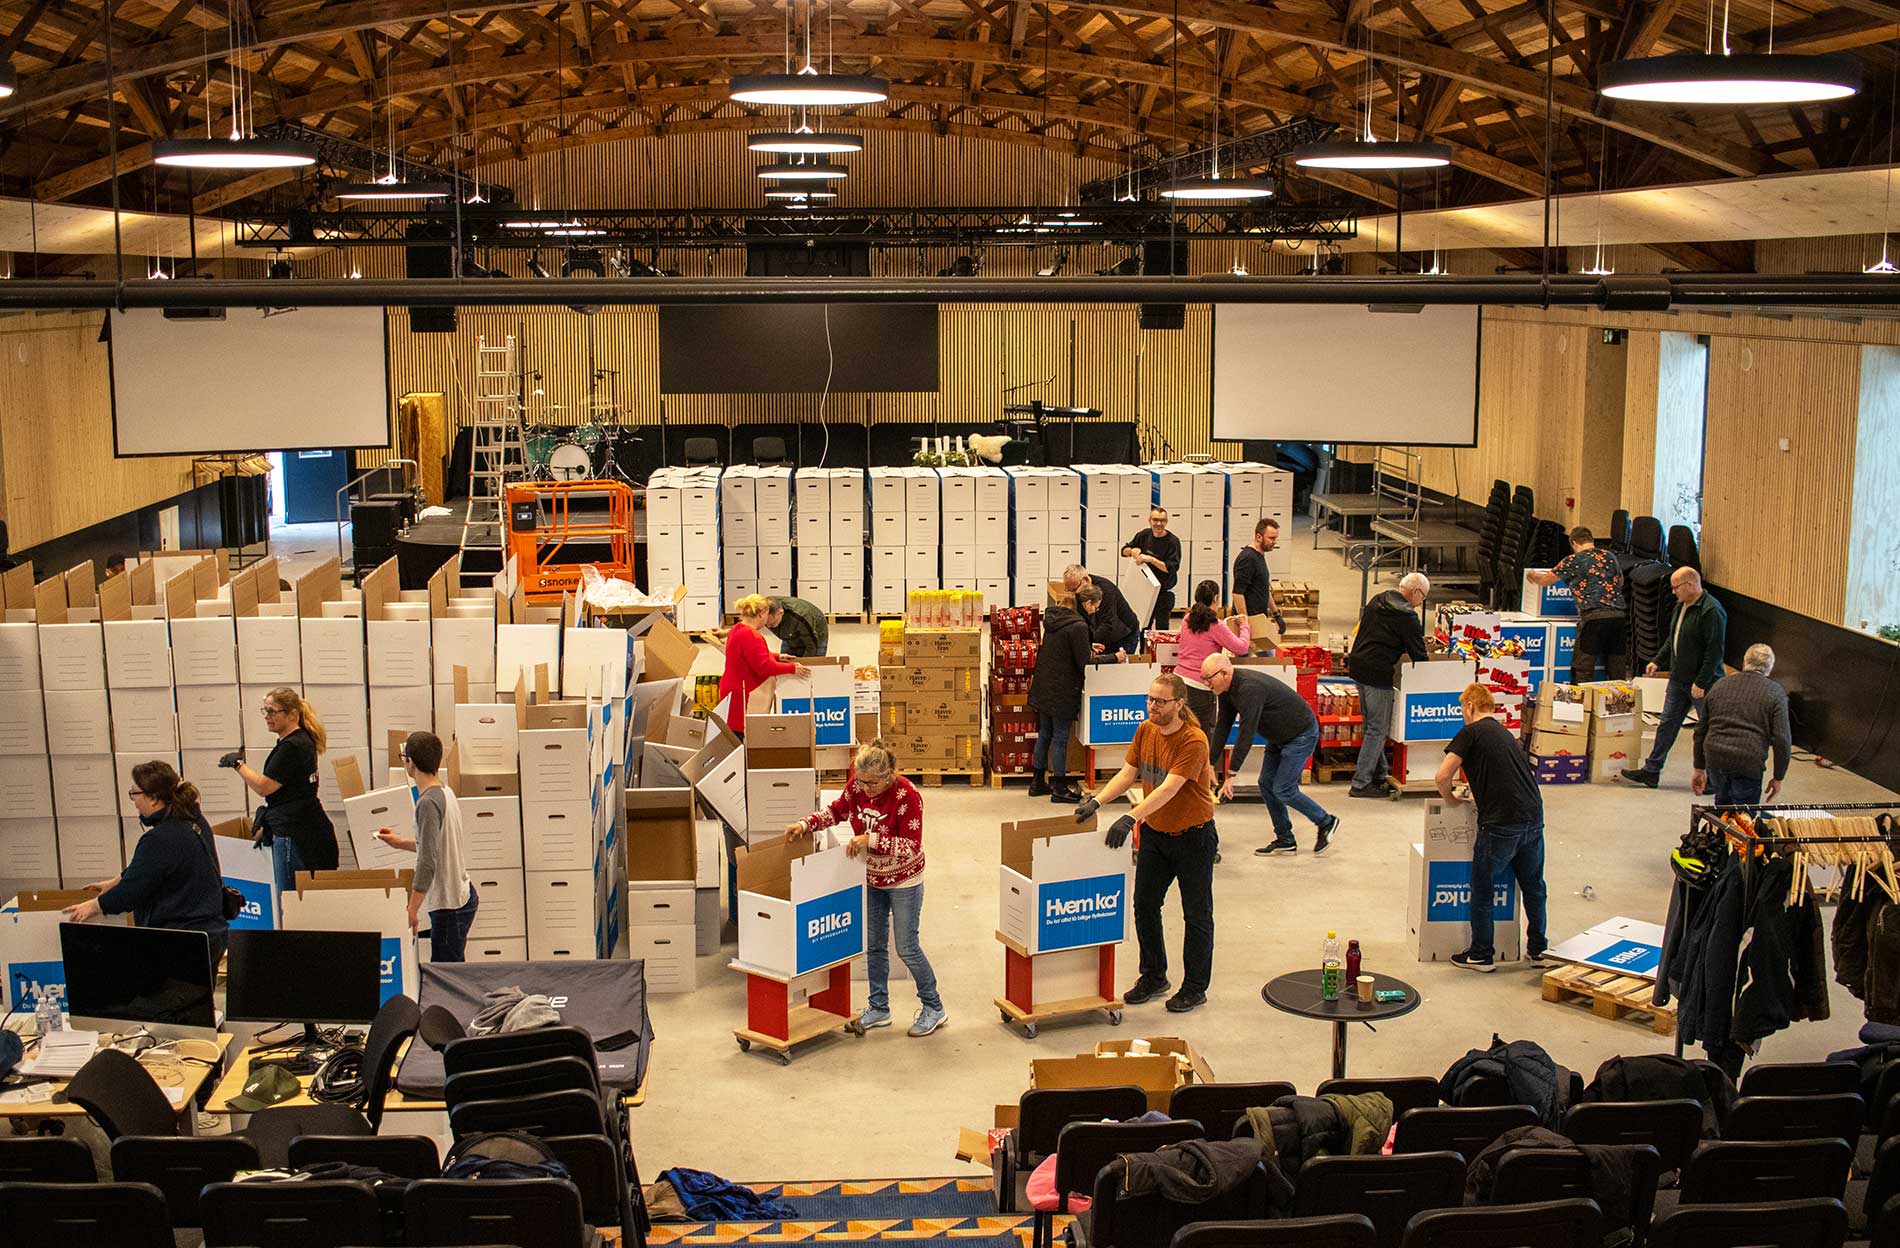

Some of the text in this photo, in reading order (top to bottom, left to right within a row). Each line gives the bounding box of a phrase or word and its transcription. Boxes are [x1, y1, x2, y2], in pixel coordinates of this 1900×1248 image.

[1101, 709, 1145, 721] Bilka
[1411, 705, 1446, 717] Hvem
[1046, 897, 1093, 917] Hvem
[807, 911, 852, 938] Bilka
[1608, 947, 1648, 964] Bilka
